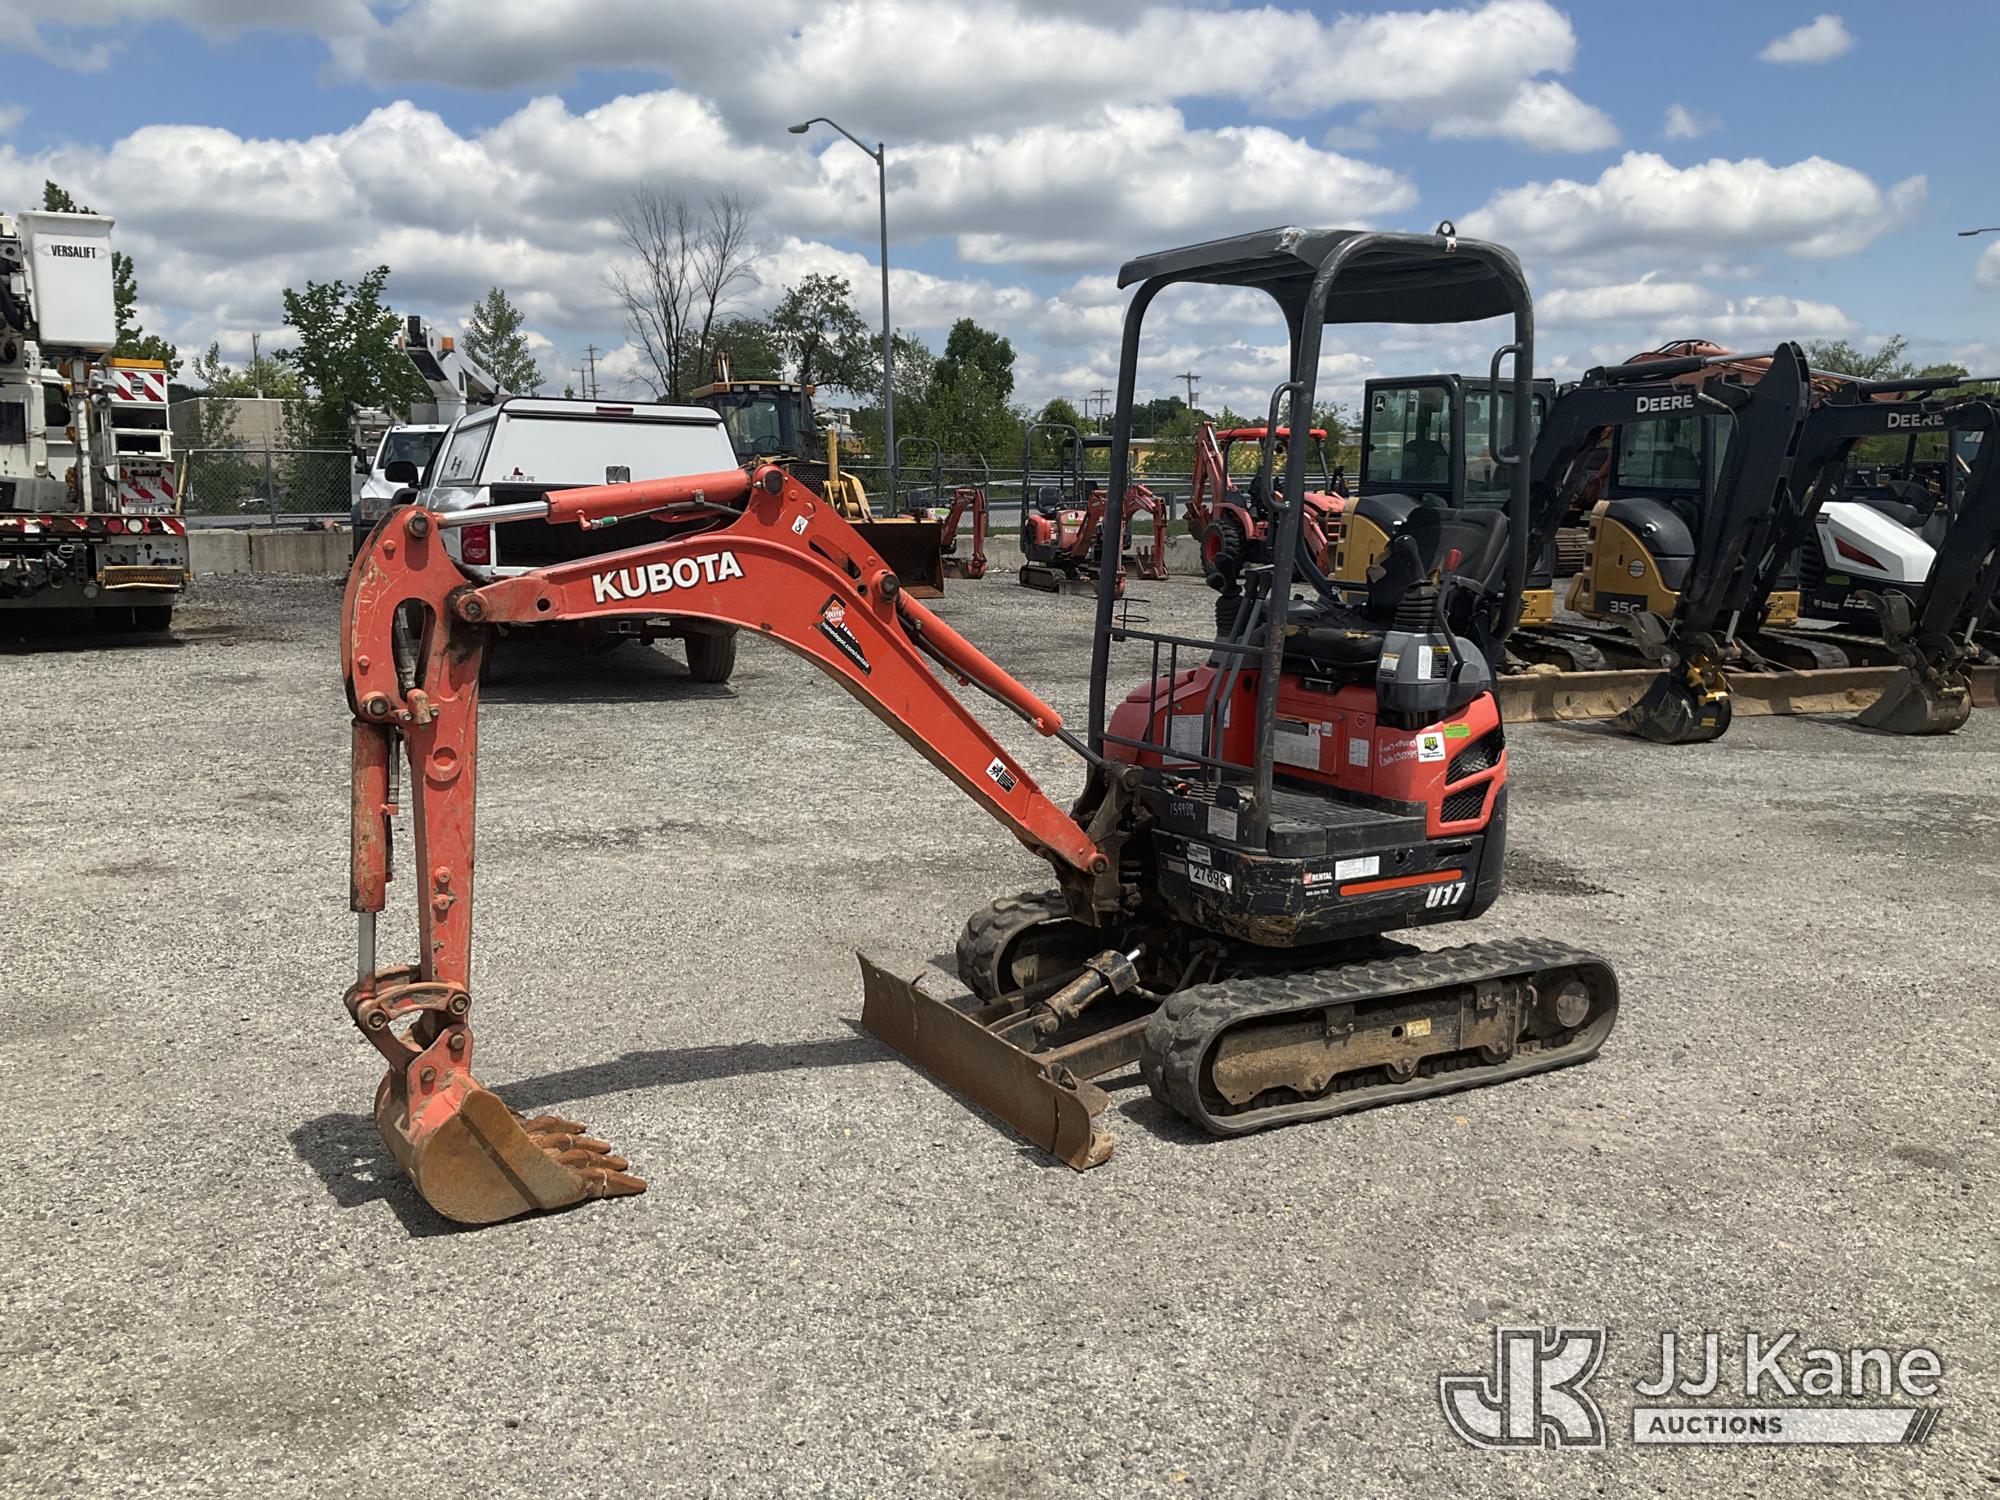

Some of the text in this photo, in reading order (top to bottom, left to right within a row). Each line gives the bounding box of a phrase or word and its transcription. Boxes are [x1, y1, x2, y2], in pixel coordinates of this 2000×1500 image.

[51, 244, 96, 259] VERSALIFT
[1636, 394, 1694, 413] DEERE
[1887, 412, 1945, 429] DEERE
[591, 550, 745, 603] KUBOTA
[1311, 872, 1333, 882] RENTAL
[1425, 881, 1467, 909] U17
